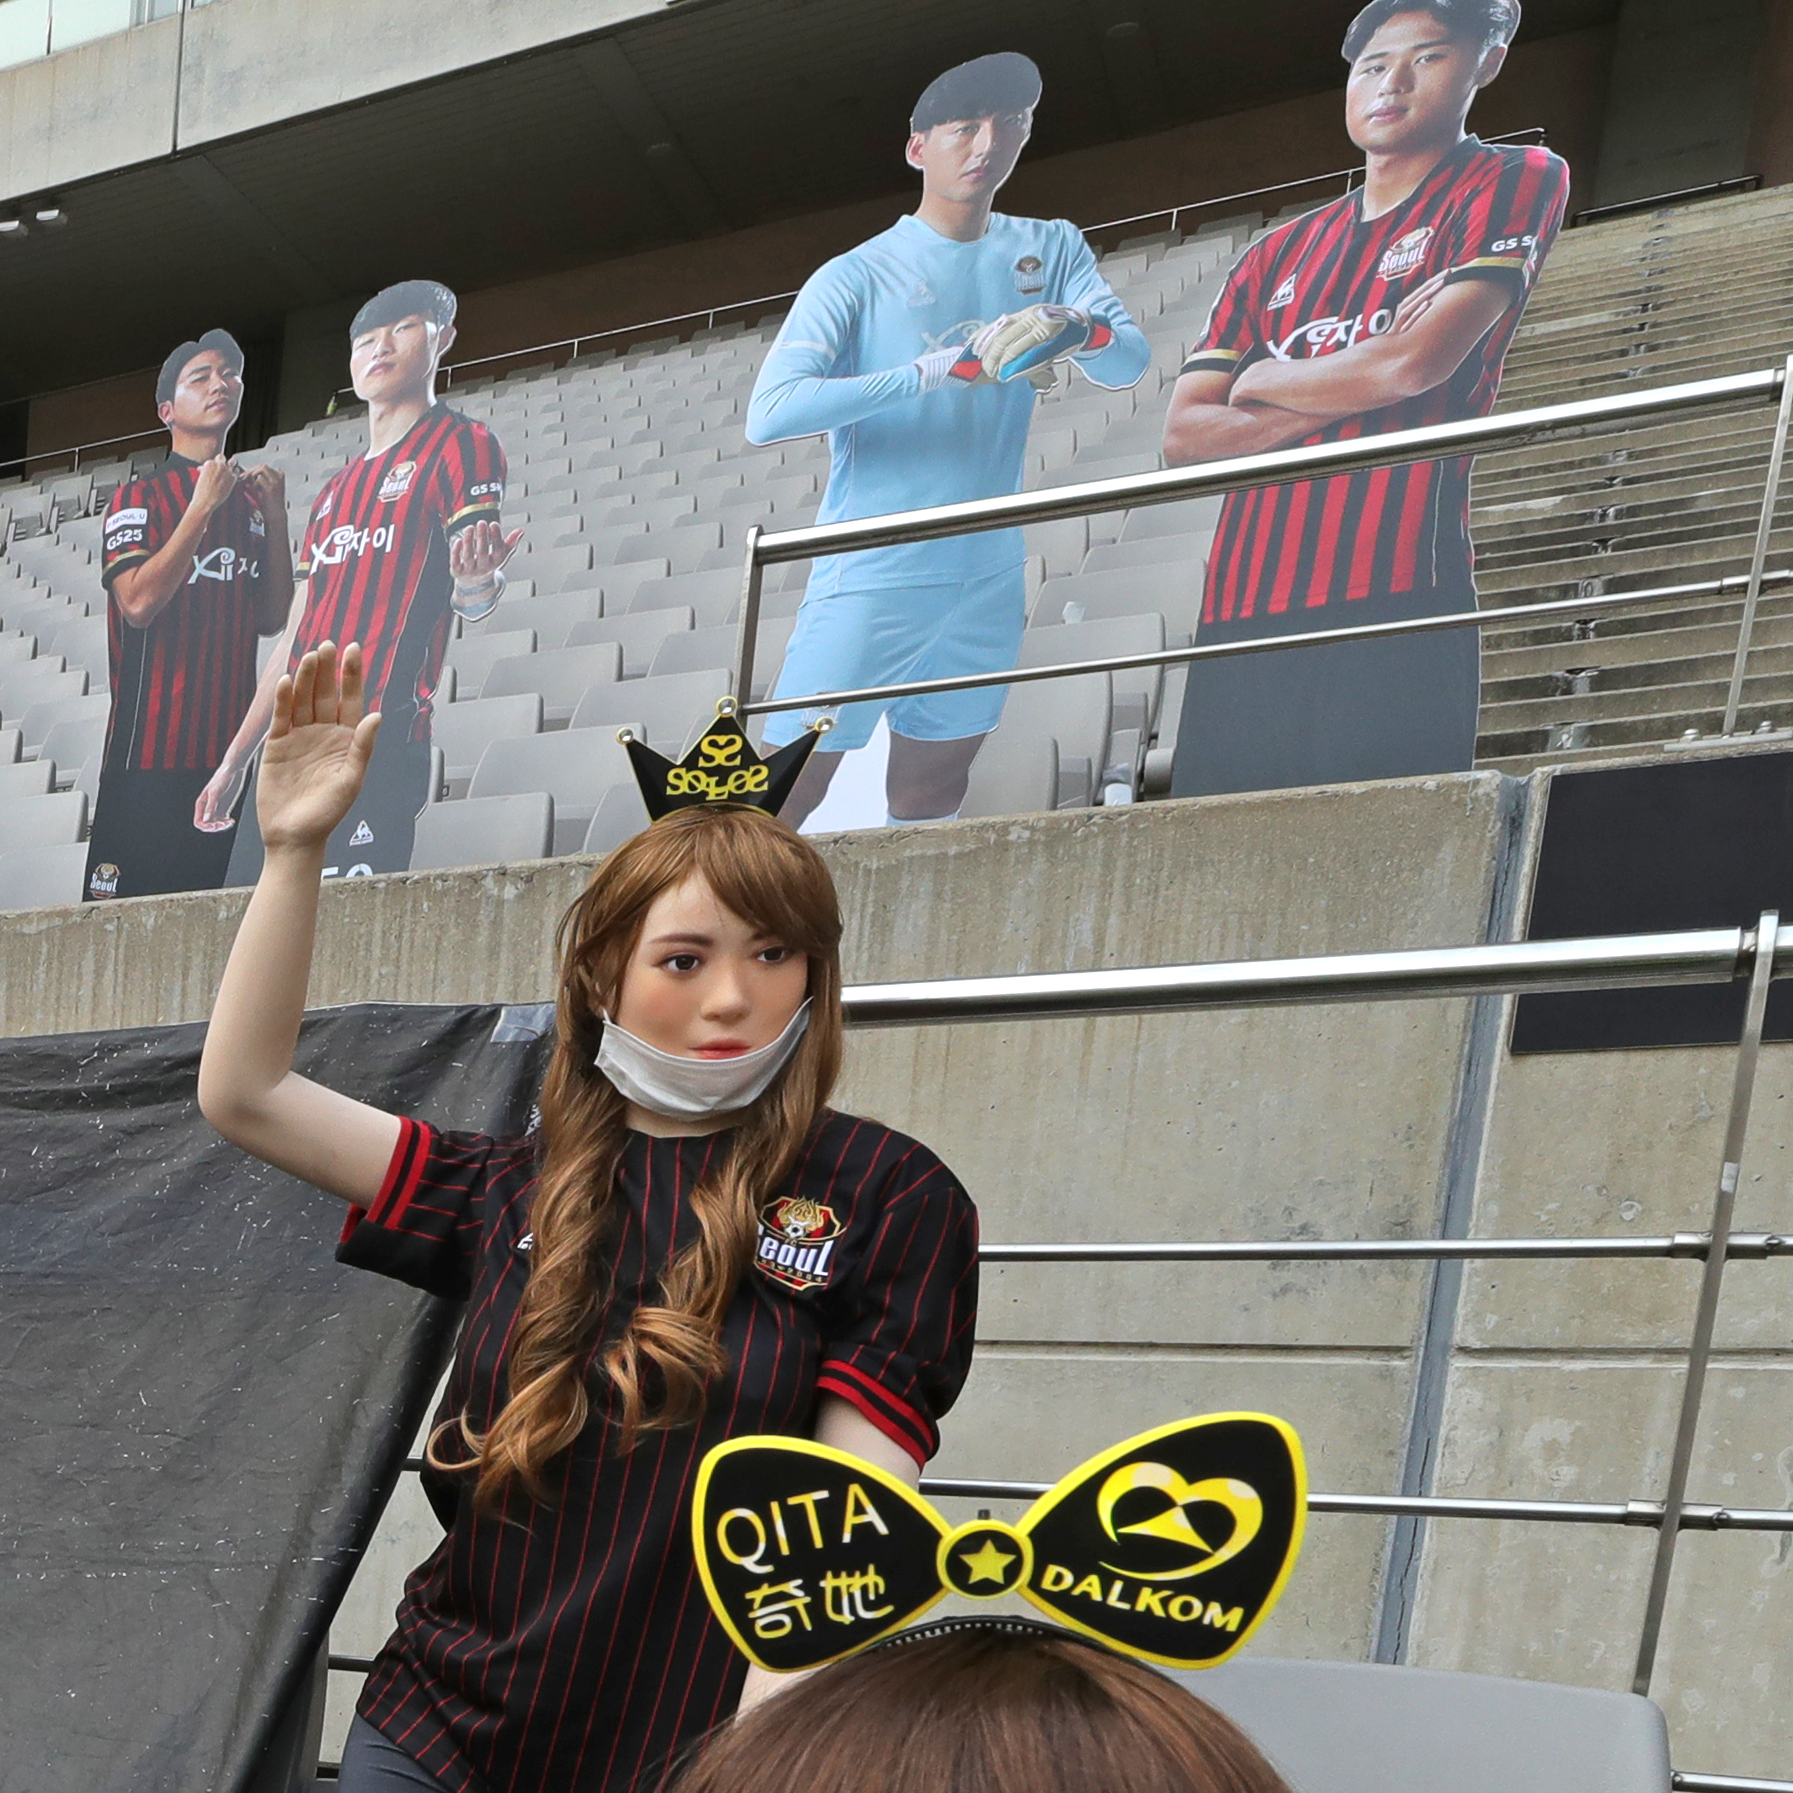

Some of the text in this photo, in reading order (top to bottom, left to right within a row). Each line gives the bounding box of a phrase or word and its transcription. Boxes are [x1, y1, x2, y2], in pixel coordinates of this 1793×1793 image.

[1379, 235, 1427, 272] Seoul
[1491, 238, 1518, 253] GS
[379, 477, 410, 496] Seoul
[470, 485, 489, 496] GS
[106, 529, 143, 551] GS25
[352, 524, 395, 557] 자이
[89, 873, 118, 894] Seoul
[758, 1223, 836, 1277] eoul
[716, 1483, 889, 1575] QITA
[1041, 1565, 1245, 1633] DALKOM
